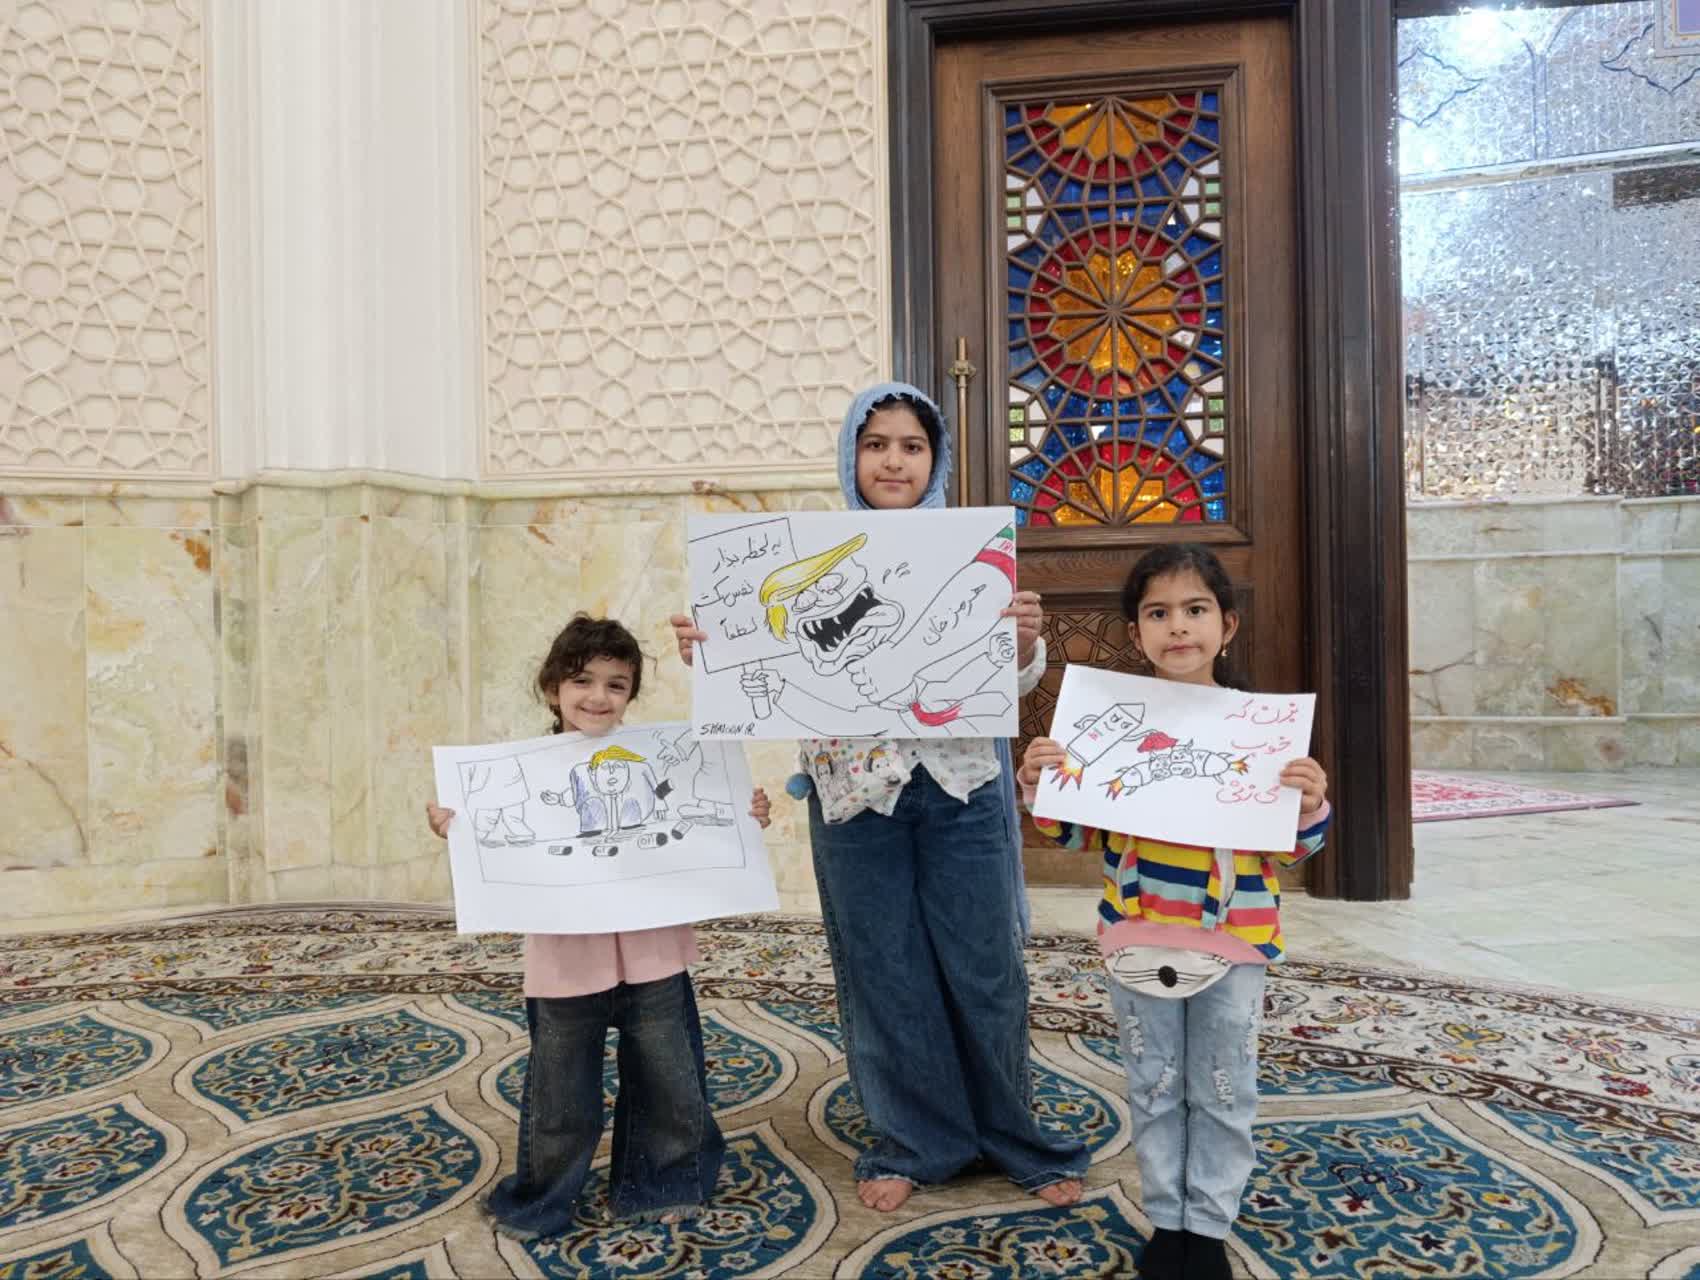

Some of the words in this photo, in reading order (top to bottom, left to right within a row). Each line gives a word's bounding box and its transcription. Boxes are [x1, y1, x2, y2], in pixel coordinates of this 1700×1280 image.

[741, 533, 769, 565] لحظه
[723, 580, 754, 608] نفس
[1223, 698, 1255, 721] که
[1251, 702, 1299, 725] بزن
[1231, 735, 1291, 757] خوب
